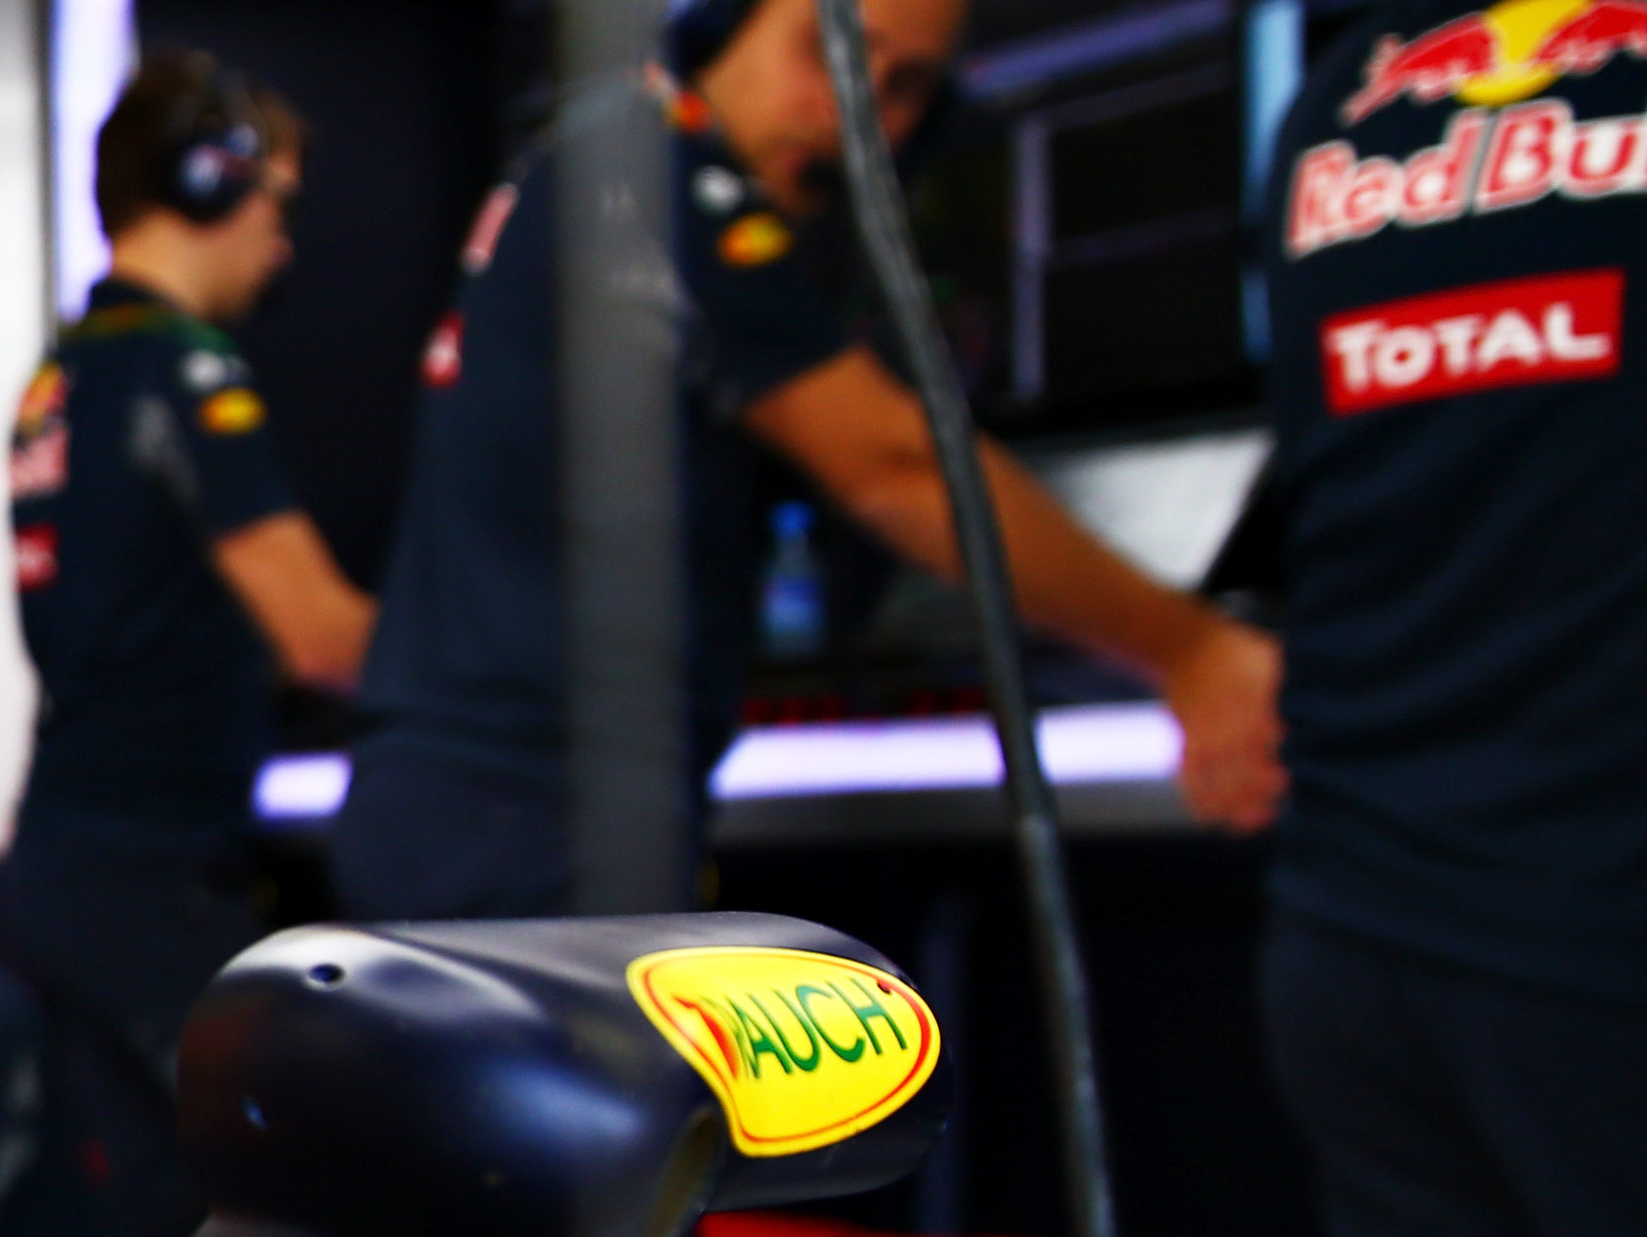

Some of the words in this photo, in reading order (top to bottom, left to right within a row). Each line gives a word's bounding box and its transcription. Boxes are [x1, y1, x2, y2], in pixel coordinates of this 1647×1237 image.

[1284, 107, 1489, 261] Red
[1472, 98, 1647, 214] Bu
[1323, 302, 1611, 393] TOTAL
